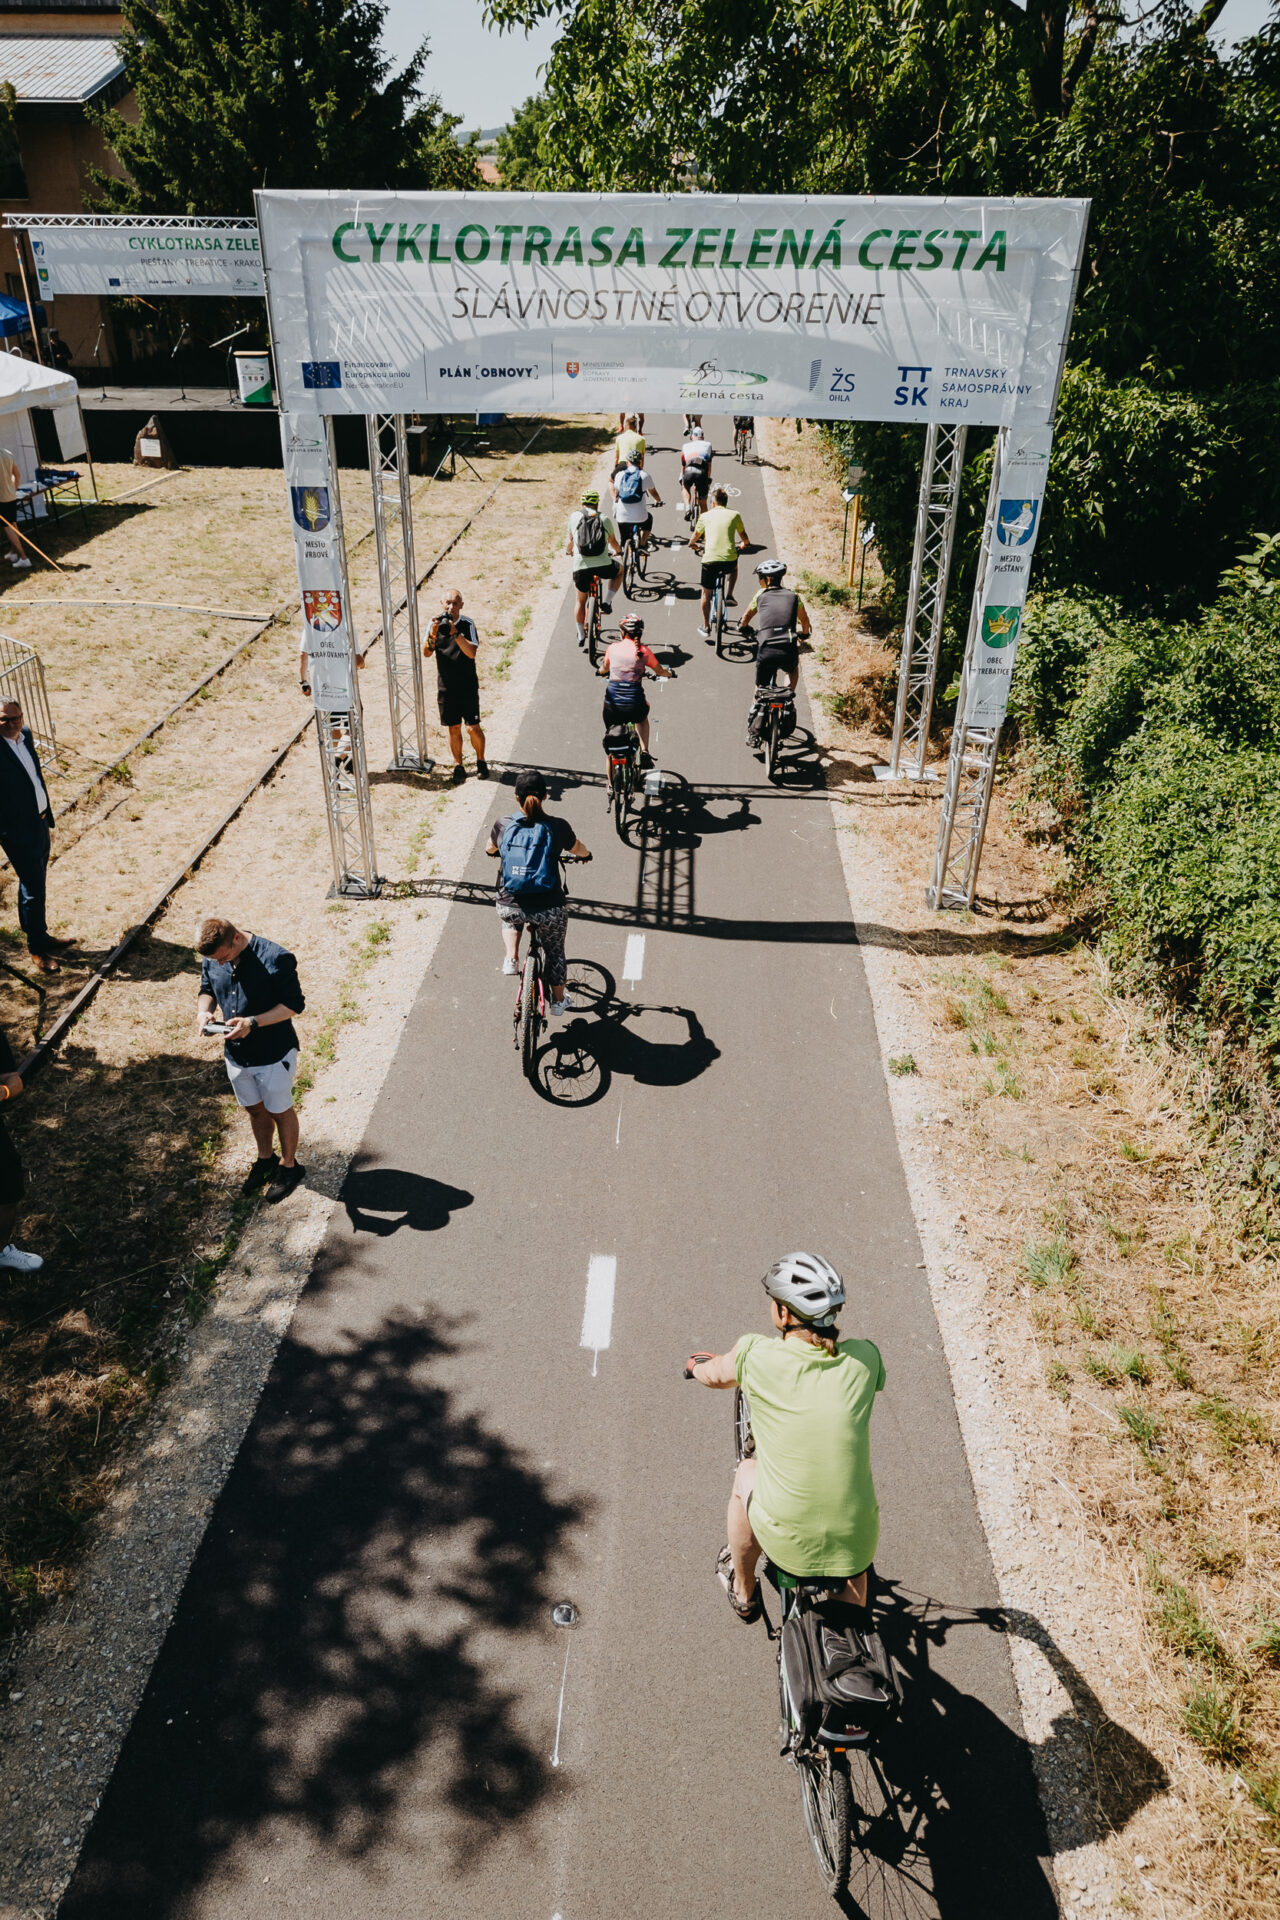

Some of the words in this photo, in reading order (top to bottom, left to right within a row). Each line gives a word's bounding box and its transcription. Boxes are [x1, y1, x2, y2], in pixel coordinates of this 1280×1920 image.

[129, 237, 223, 251] CYKLOTRASA
[226, 238, 260, 251] ZELE
[331, 221, 647, 268] CYKLOTRASA
[658, 219, 846, 270] ZELENÁ
[858, 228, 1007, 272] CESTA
[234, 259, 261, 267] KRAKO
[452, 281, 679, 321] SLÁVNOSTNÉ
[685, 289, 885, 325] OTVORENIE
[439, 365, 472, 378] PLÁN
[944, 367, 1007, 379] TRNAVSKÝ
[829, 367, 856, 393] ŽS
[679, 388, 725, 400] Zelená
[729, 391, 765, 401] cesta
[942, 382, 1032, 395] SAMOSPRÁVNY
[829, 394, 851, 402] OHLA
[894, 386, 929, 407] SK
[940, 398, 969, 408] KRAJ
[305, 541, 326, 549] MESTO
[1000, 555, 1021, 563] MESTO
